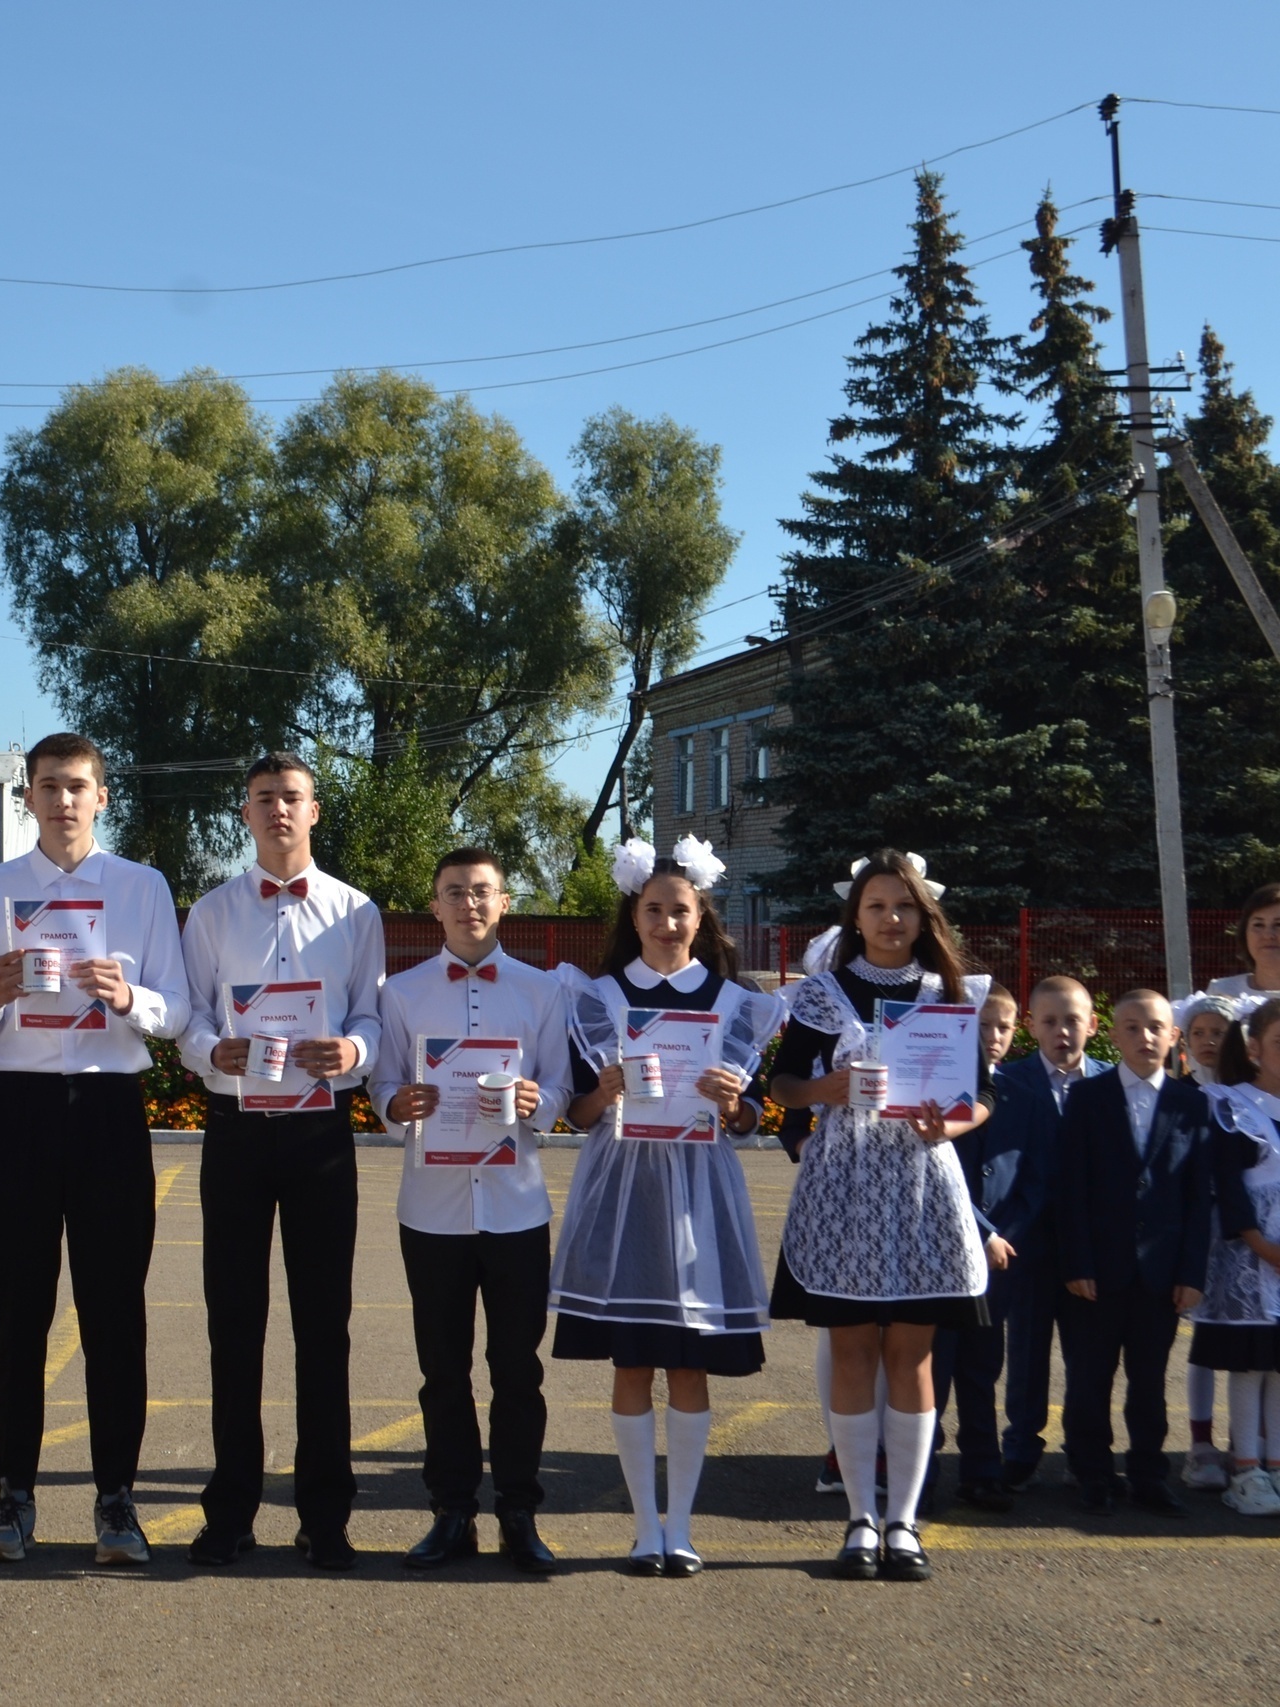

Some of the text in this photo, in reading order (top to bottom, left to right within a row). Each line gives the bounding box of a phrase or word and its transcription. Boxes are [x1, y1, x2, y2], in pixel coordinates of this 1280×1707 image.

[34, 957, 60, 970] Перв
[260, 1014, 298, 1022] ГРАМОТА
[652, 1043, 691, 1051] ГРАМОТА
[859, 1077, 888, 1089] Перв
